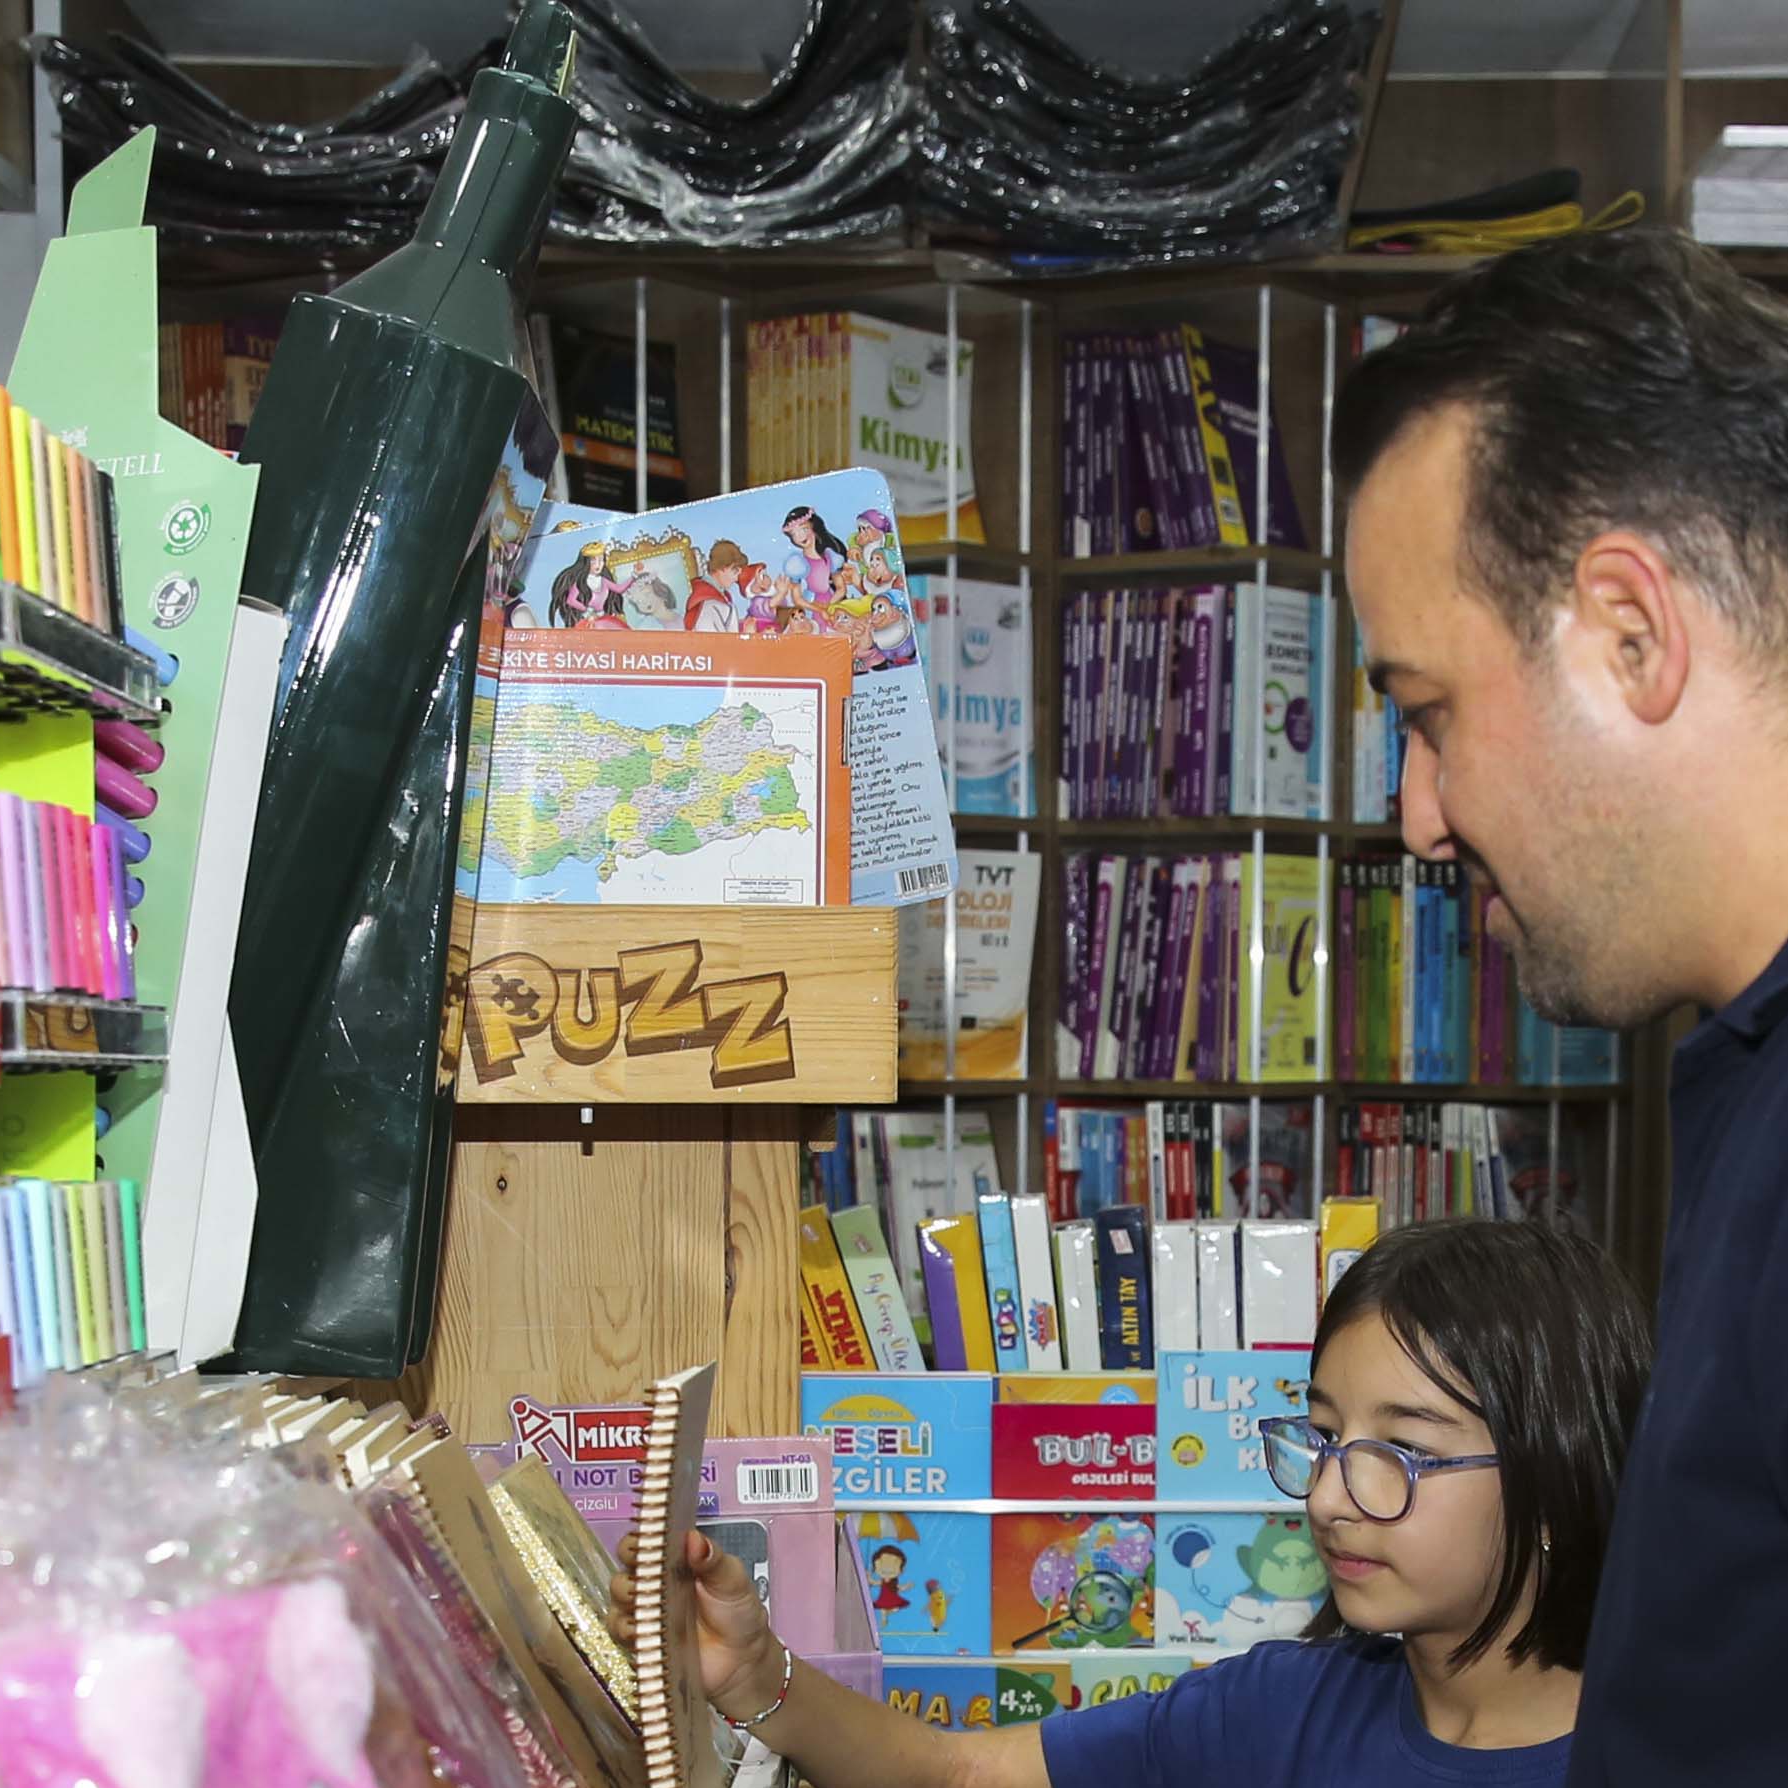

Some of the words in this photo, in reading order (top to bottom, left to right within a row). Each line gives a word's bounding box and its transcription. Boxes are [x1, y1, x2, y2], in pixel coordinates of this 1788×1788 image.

[555, 650, 616, 671] SİYASİ
[622, 652, 713, 672] HARİTASI
[1119, 1276, 1138, 1303] TAY
[1121, 1306, 1140, 1346] ALTIN
[1183, 1363, 1259, 1412] İLK
[578, 1421, 654, 1450] MİKR
[781, 1454, 812, 1465] NT-03
[573, 1467, 618, 1486] NOT
[574, 1497, 619, 1512] ÇİZGİLİ
